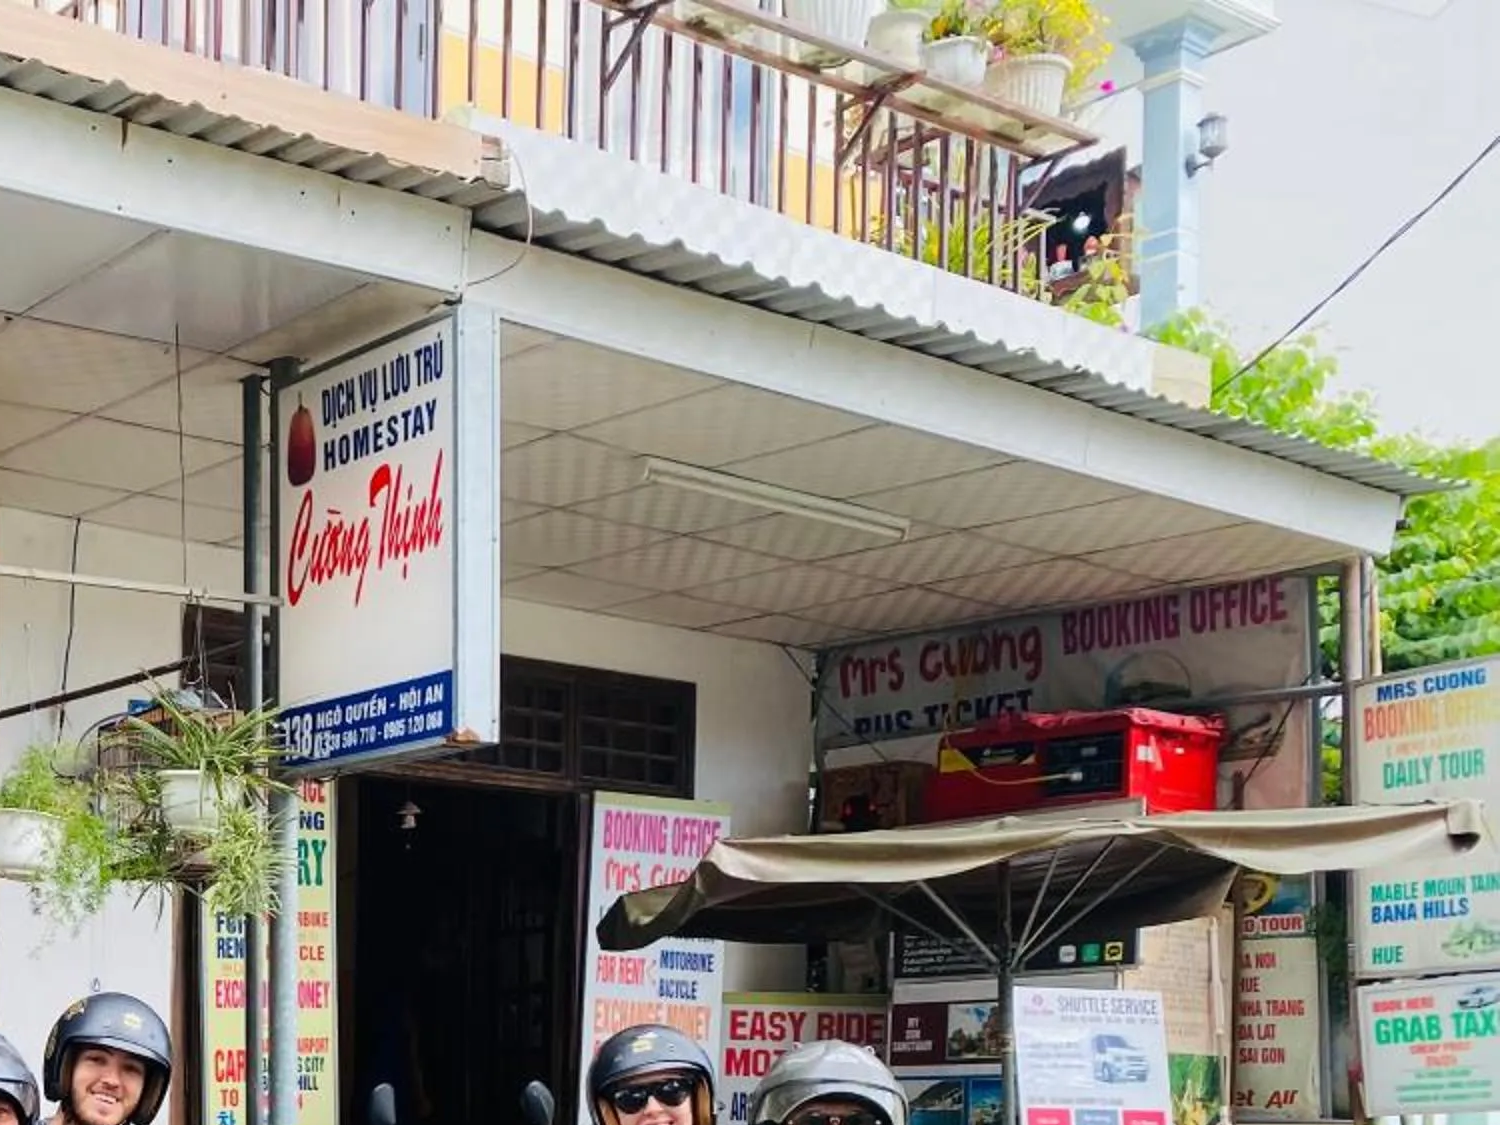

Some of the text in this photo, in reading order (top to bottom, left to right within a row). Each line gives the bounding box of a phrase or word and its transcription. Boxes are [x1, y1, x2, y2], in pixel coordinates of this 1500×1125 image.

[321, 377, 356, 429] DỊCH
[323, 398, 437, 471] HOMESTAY
[368, 449, 444, 580] Thịnh
[1062, 594, 1181, 656] BOOKING
[1189, 576, 1288, 633] OFFICE
[1376, 668, 1486, 702] MRS CUONG
[284, 713, 313, 762] 138
[425, 683, 444, 704] AN
[1383, 748, 1485, 789] DAILY TOUR
[299, 810, 326, 831] NG
[603, 810, 669, 854] BOOKING
[297, 838, 327, 887] RY
[1371, 881, 1419, 902] MABLE
[1371, 897, 1469, 925] BANA HILLS
[1260, 916, 1302, 933] TOUR
[217, 937, 246, 959] REN
[299, 945, 326, 961] CLE
[660, 949, 715, 973] MOTORBIKE
[1371, 945, 1404, 965] HUE
[297, 979, 331, 1009] ONEY
[658, 978, 698, 1000] BICYCLE
[1057, 996, 1158, 1015] SHUTTLE SERVICE
[1266, 1000, 1305, 1017] TRANG
[729, 1009, 885, 1043] EASY RIDE
[1258, 1023, 1277, 1041] LAT
[1375, 1008, 1500, 1045] GRAB TAX
[1261, 1047, 1285, 1064] GON
[220, 1088, 240, 1108] TO
